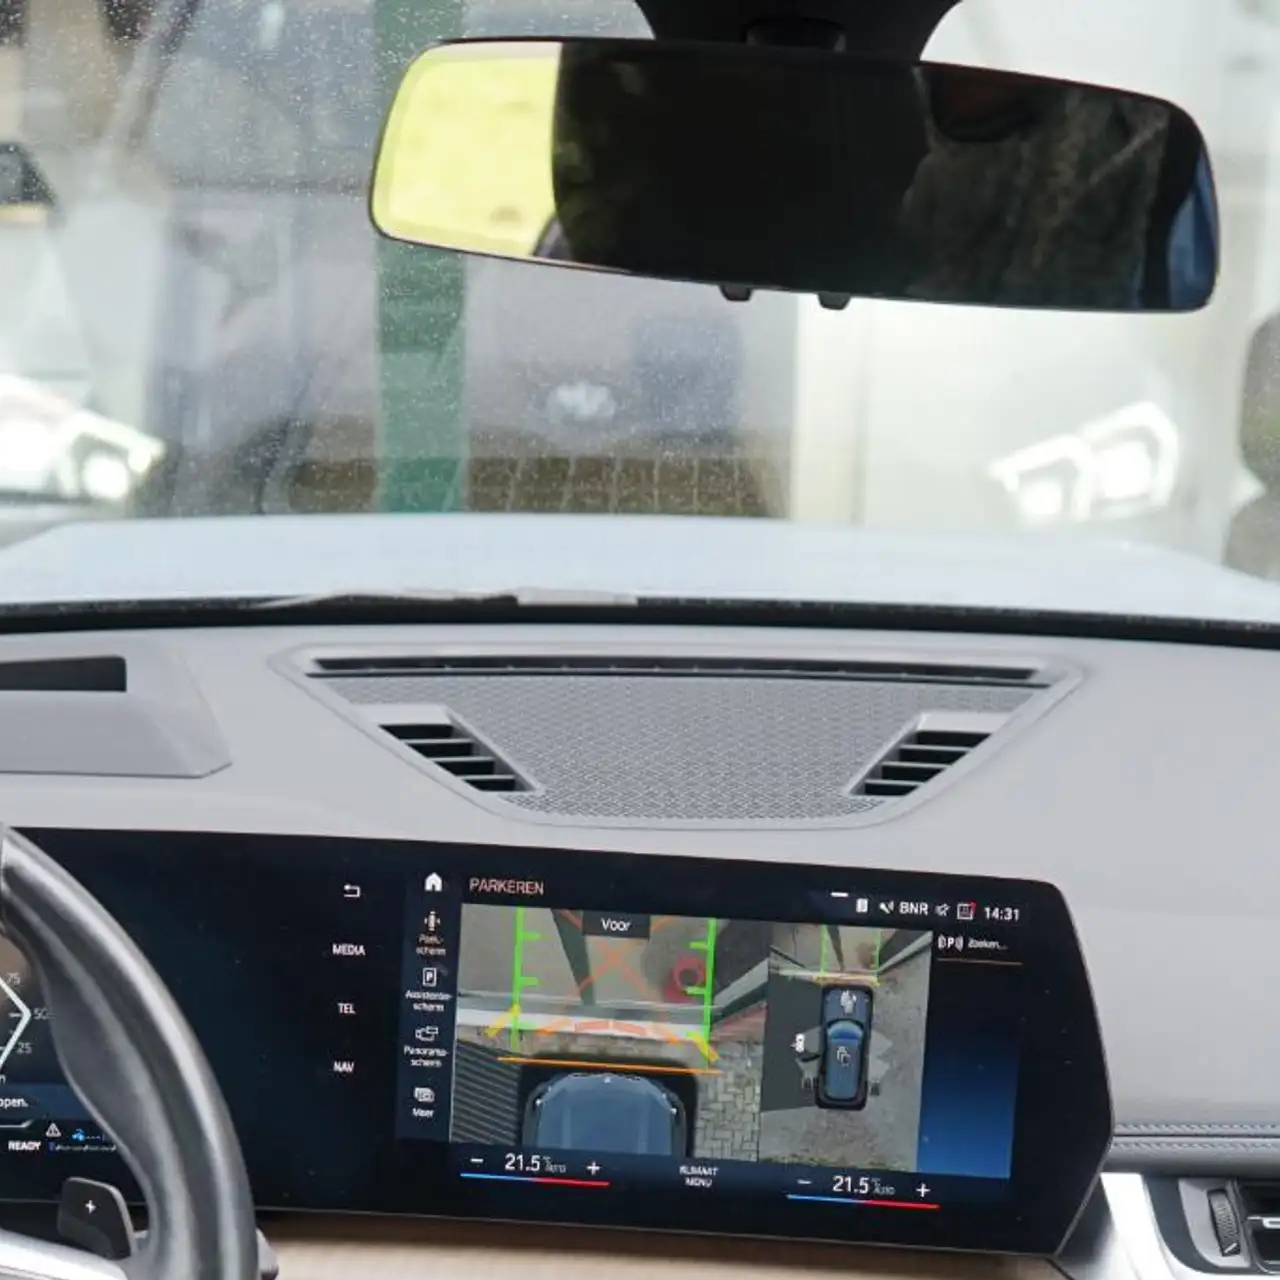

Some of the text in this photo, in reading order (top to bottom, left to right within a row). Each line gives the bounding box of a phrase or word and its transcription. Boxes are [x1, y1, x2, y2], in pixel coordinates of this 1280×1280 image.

[470, 878, 545, 895] PARKEREN
[899, 902, 929, 916] BNR
[985, 907, 1020, 921] 14:31
[601, 918, 631, 931] Voor
[332, 944, 366, 956] MEDIA
[338, 1003, 356, 1014] TEL
[17, 1042, 32, 1054] 25
[333, 1061, 355, 1073] NAV
[8, 1140, 42, 1151] READY
[504, 1153, 541, 1171] 21.5
[832, 1175, 870, 1194] 21.5
